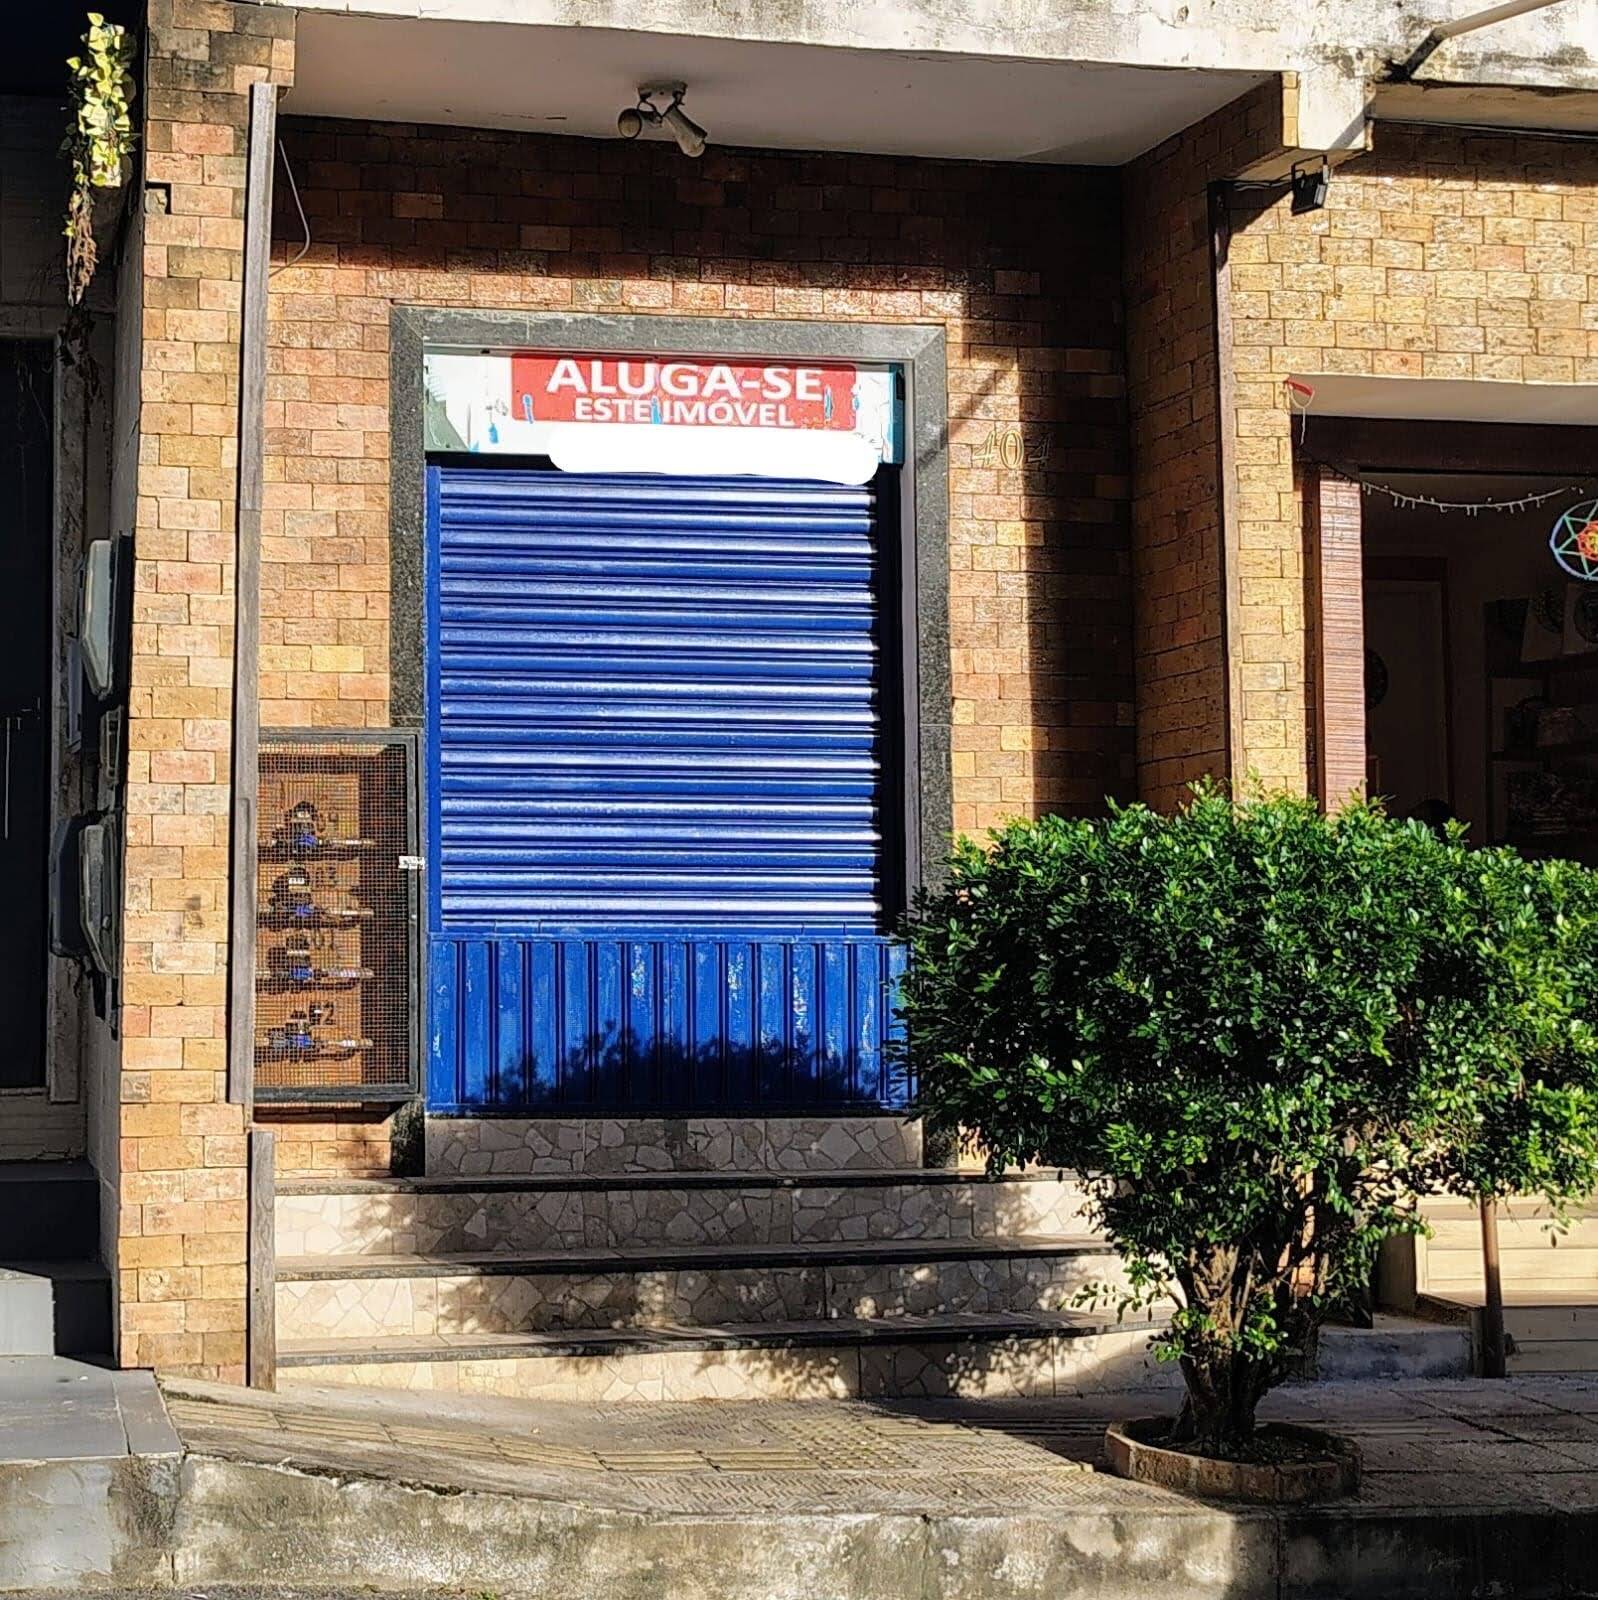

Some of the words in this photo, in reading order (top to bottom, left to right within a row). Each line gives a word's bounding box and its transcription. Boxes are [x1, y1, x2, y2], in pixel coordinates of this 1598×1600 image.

[546, 358, 824, 401] ALUGA-SE
[574, 397, 652, 424] ESTE
[662, 396, 795, 427] IMÓVEL
[970, 429, 1055, 470] 404
